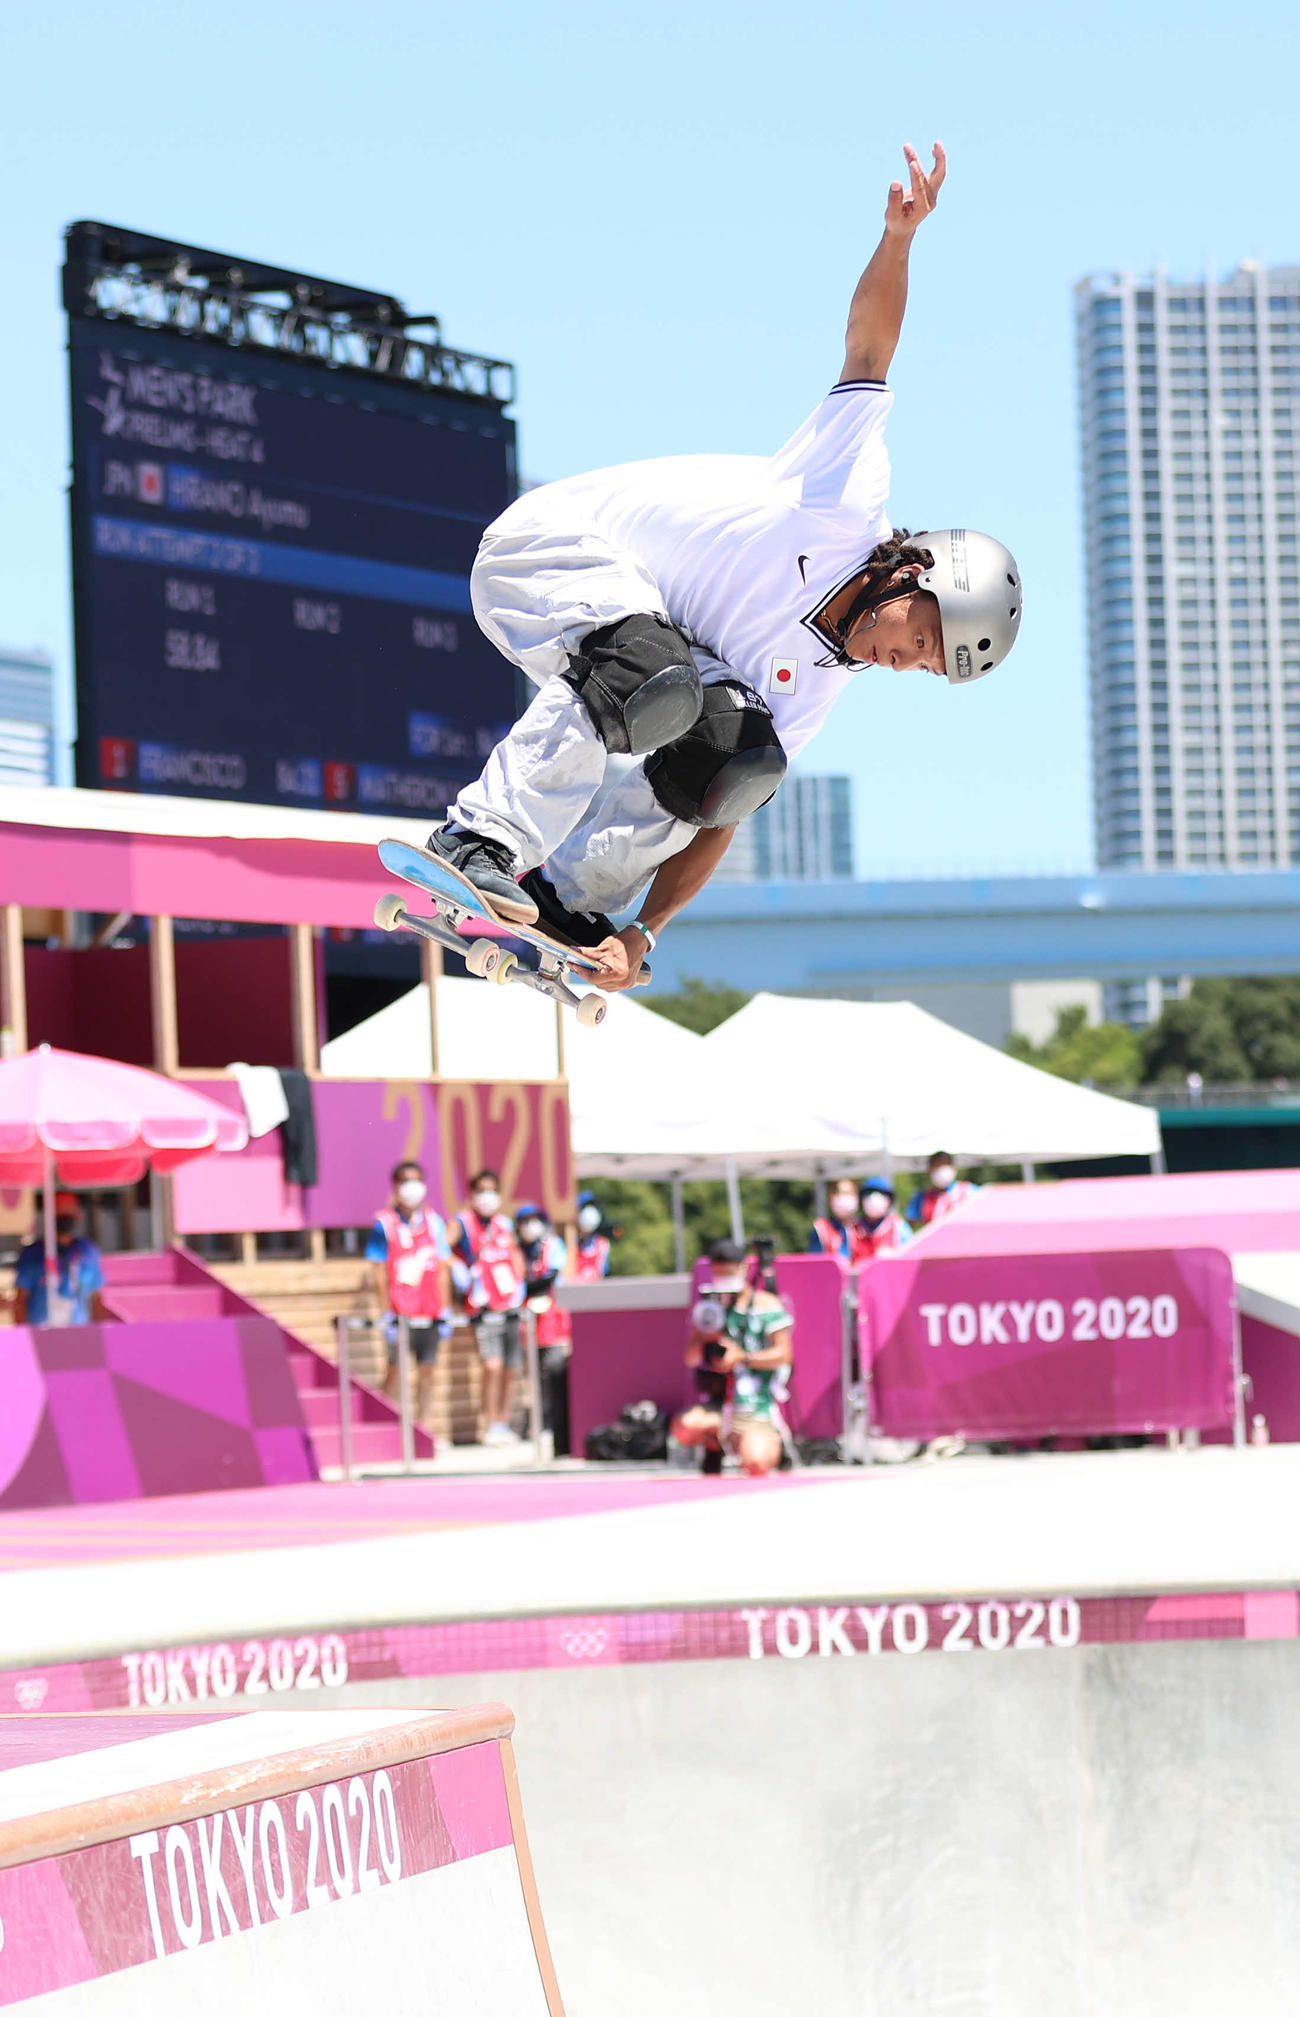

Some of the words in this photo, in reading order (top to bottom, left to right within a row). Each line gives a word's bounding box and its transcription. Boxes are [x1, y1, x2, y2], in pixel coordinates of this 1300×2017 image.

[196, 375, 259, 426] PARK
[382, 1081, 576, 1224] 2020
[919, 1299, 1065, 1348] TOKYO
[1071, 1294, 1179, 1341] 2020
[739, 1601, 930, 1661] TOKYO
[940, 1596, 1082, 1653] 2020
[121, 1643, 238, 1709] TOKYO
[241, 1633, 349, 1696] 2020
[128, 1799, 294, 1959] TOKYO
[295, 1769, 402, 1910] 2020
